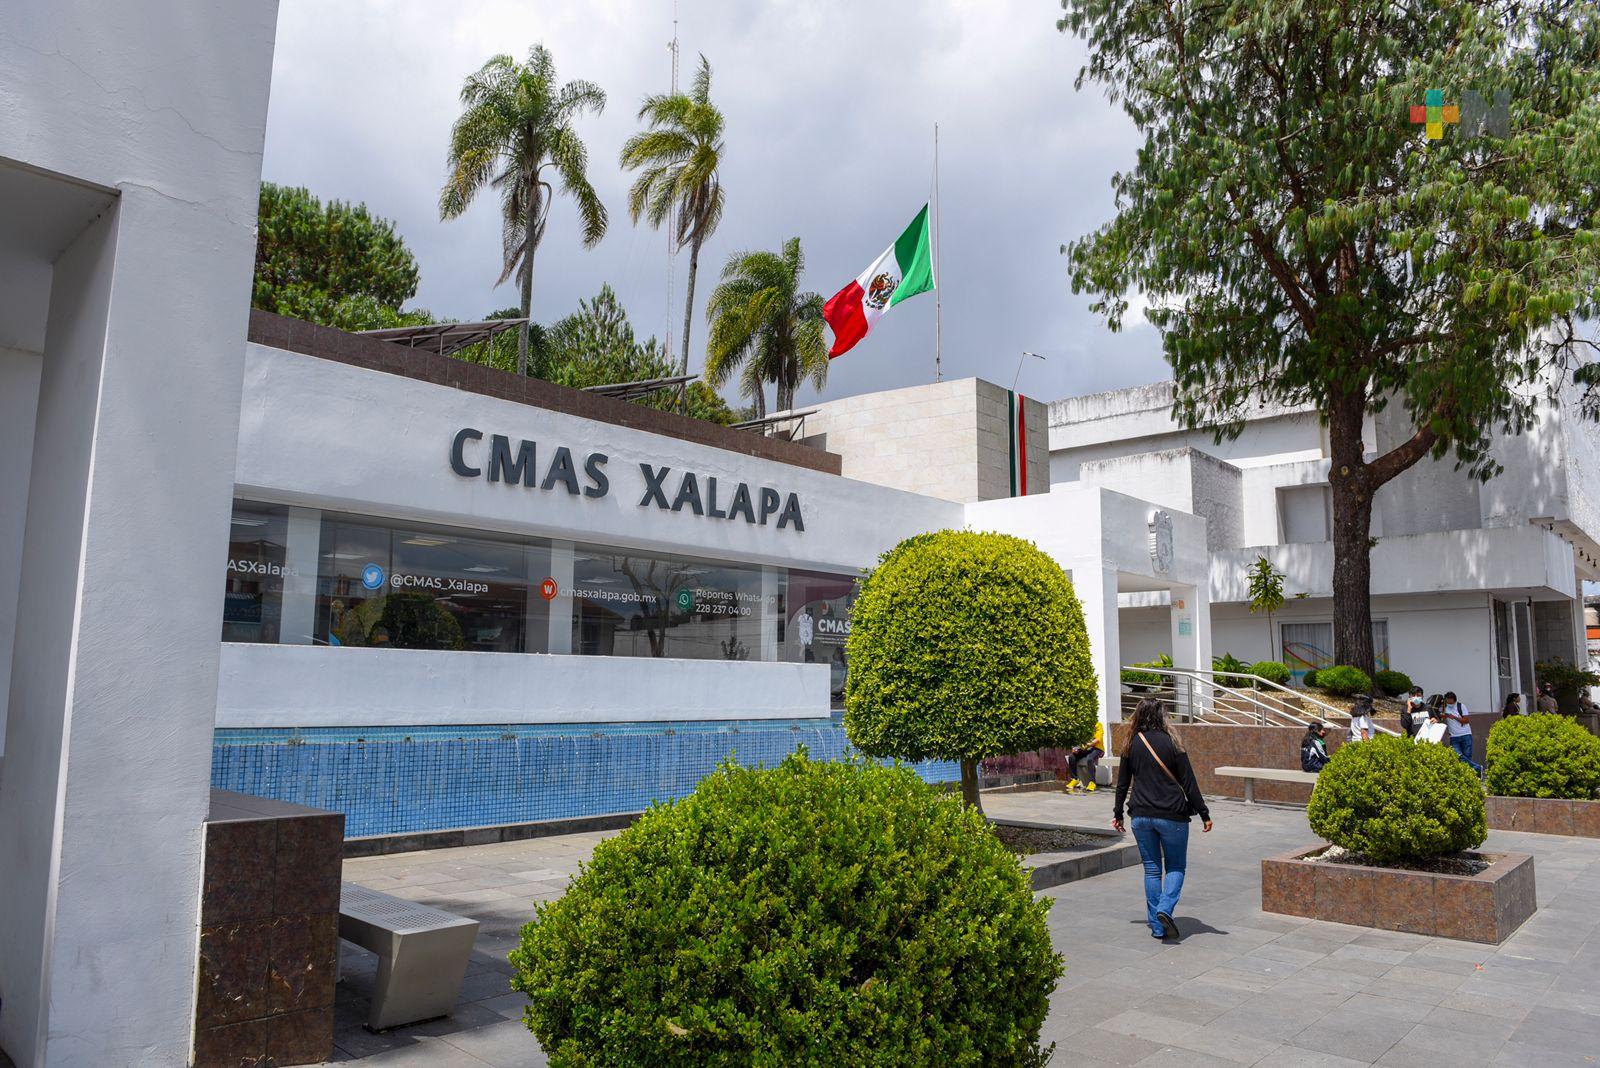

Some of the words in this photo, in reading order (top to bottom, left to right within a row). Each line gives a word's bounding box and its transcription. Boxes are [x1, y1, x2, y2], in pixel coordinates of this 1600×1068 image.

[450, 427, 609, 498] CMAS
[639, 463, 805, 532] XALAPA
[390, 574, 489, 594] @CMAS_Xalapa
[560, 588, 657, 603] cmasxalapa.gob.mx
[696, 589, 733, 600] Reportes
[696, 604, 711, 613] 228
[712, 605, 727, 614] 237
[728, 606, 739, 615] 04
[740, 607, 752, 616] 00
